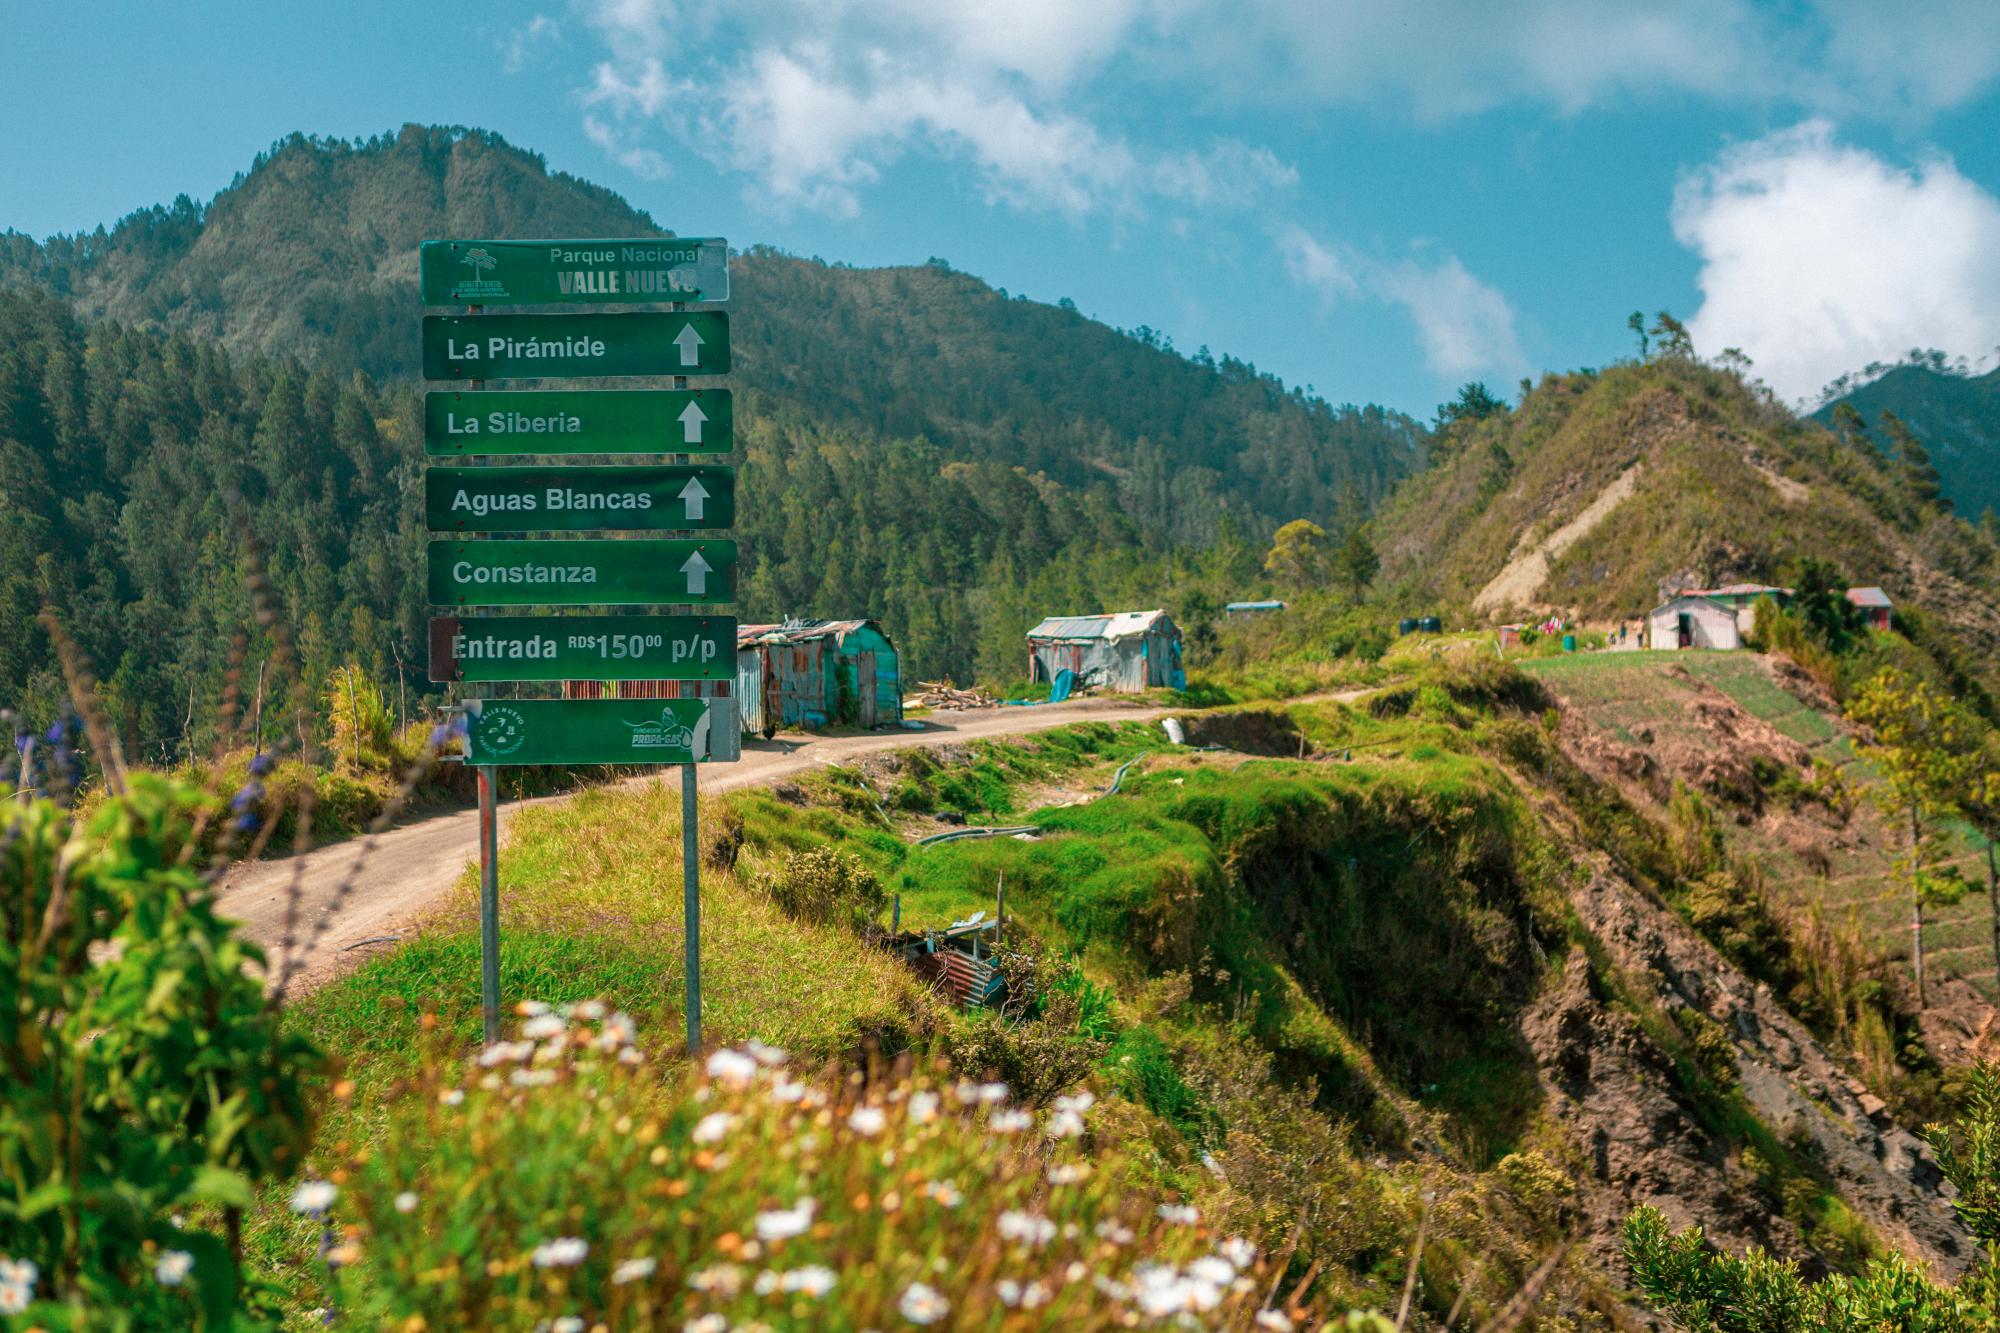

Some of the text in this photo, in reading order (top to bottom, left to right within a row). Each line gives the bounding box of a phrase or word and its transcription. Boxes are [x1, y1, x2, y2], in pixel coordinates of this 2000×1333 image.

[550, 246, 701, 266] Parque Nacional
[557, 270, 698, 294] VALLE NUEVO
[448, 336, 606, 360] La Pirámide
[448, 411, 581, 434] La Siberia
[451, 487, 652, 516] Aguas Blancas
[452, 561, 597, 583] Constanza
[451, 634, 557, 659] Entrada
[672, 634, 716, 663] p/p
[632, 734, 682, 744] PROPA-GAS
